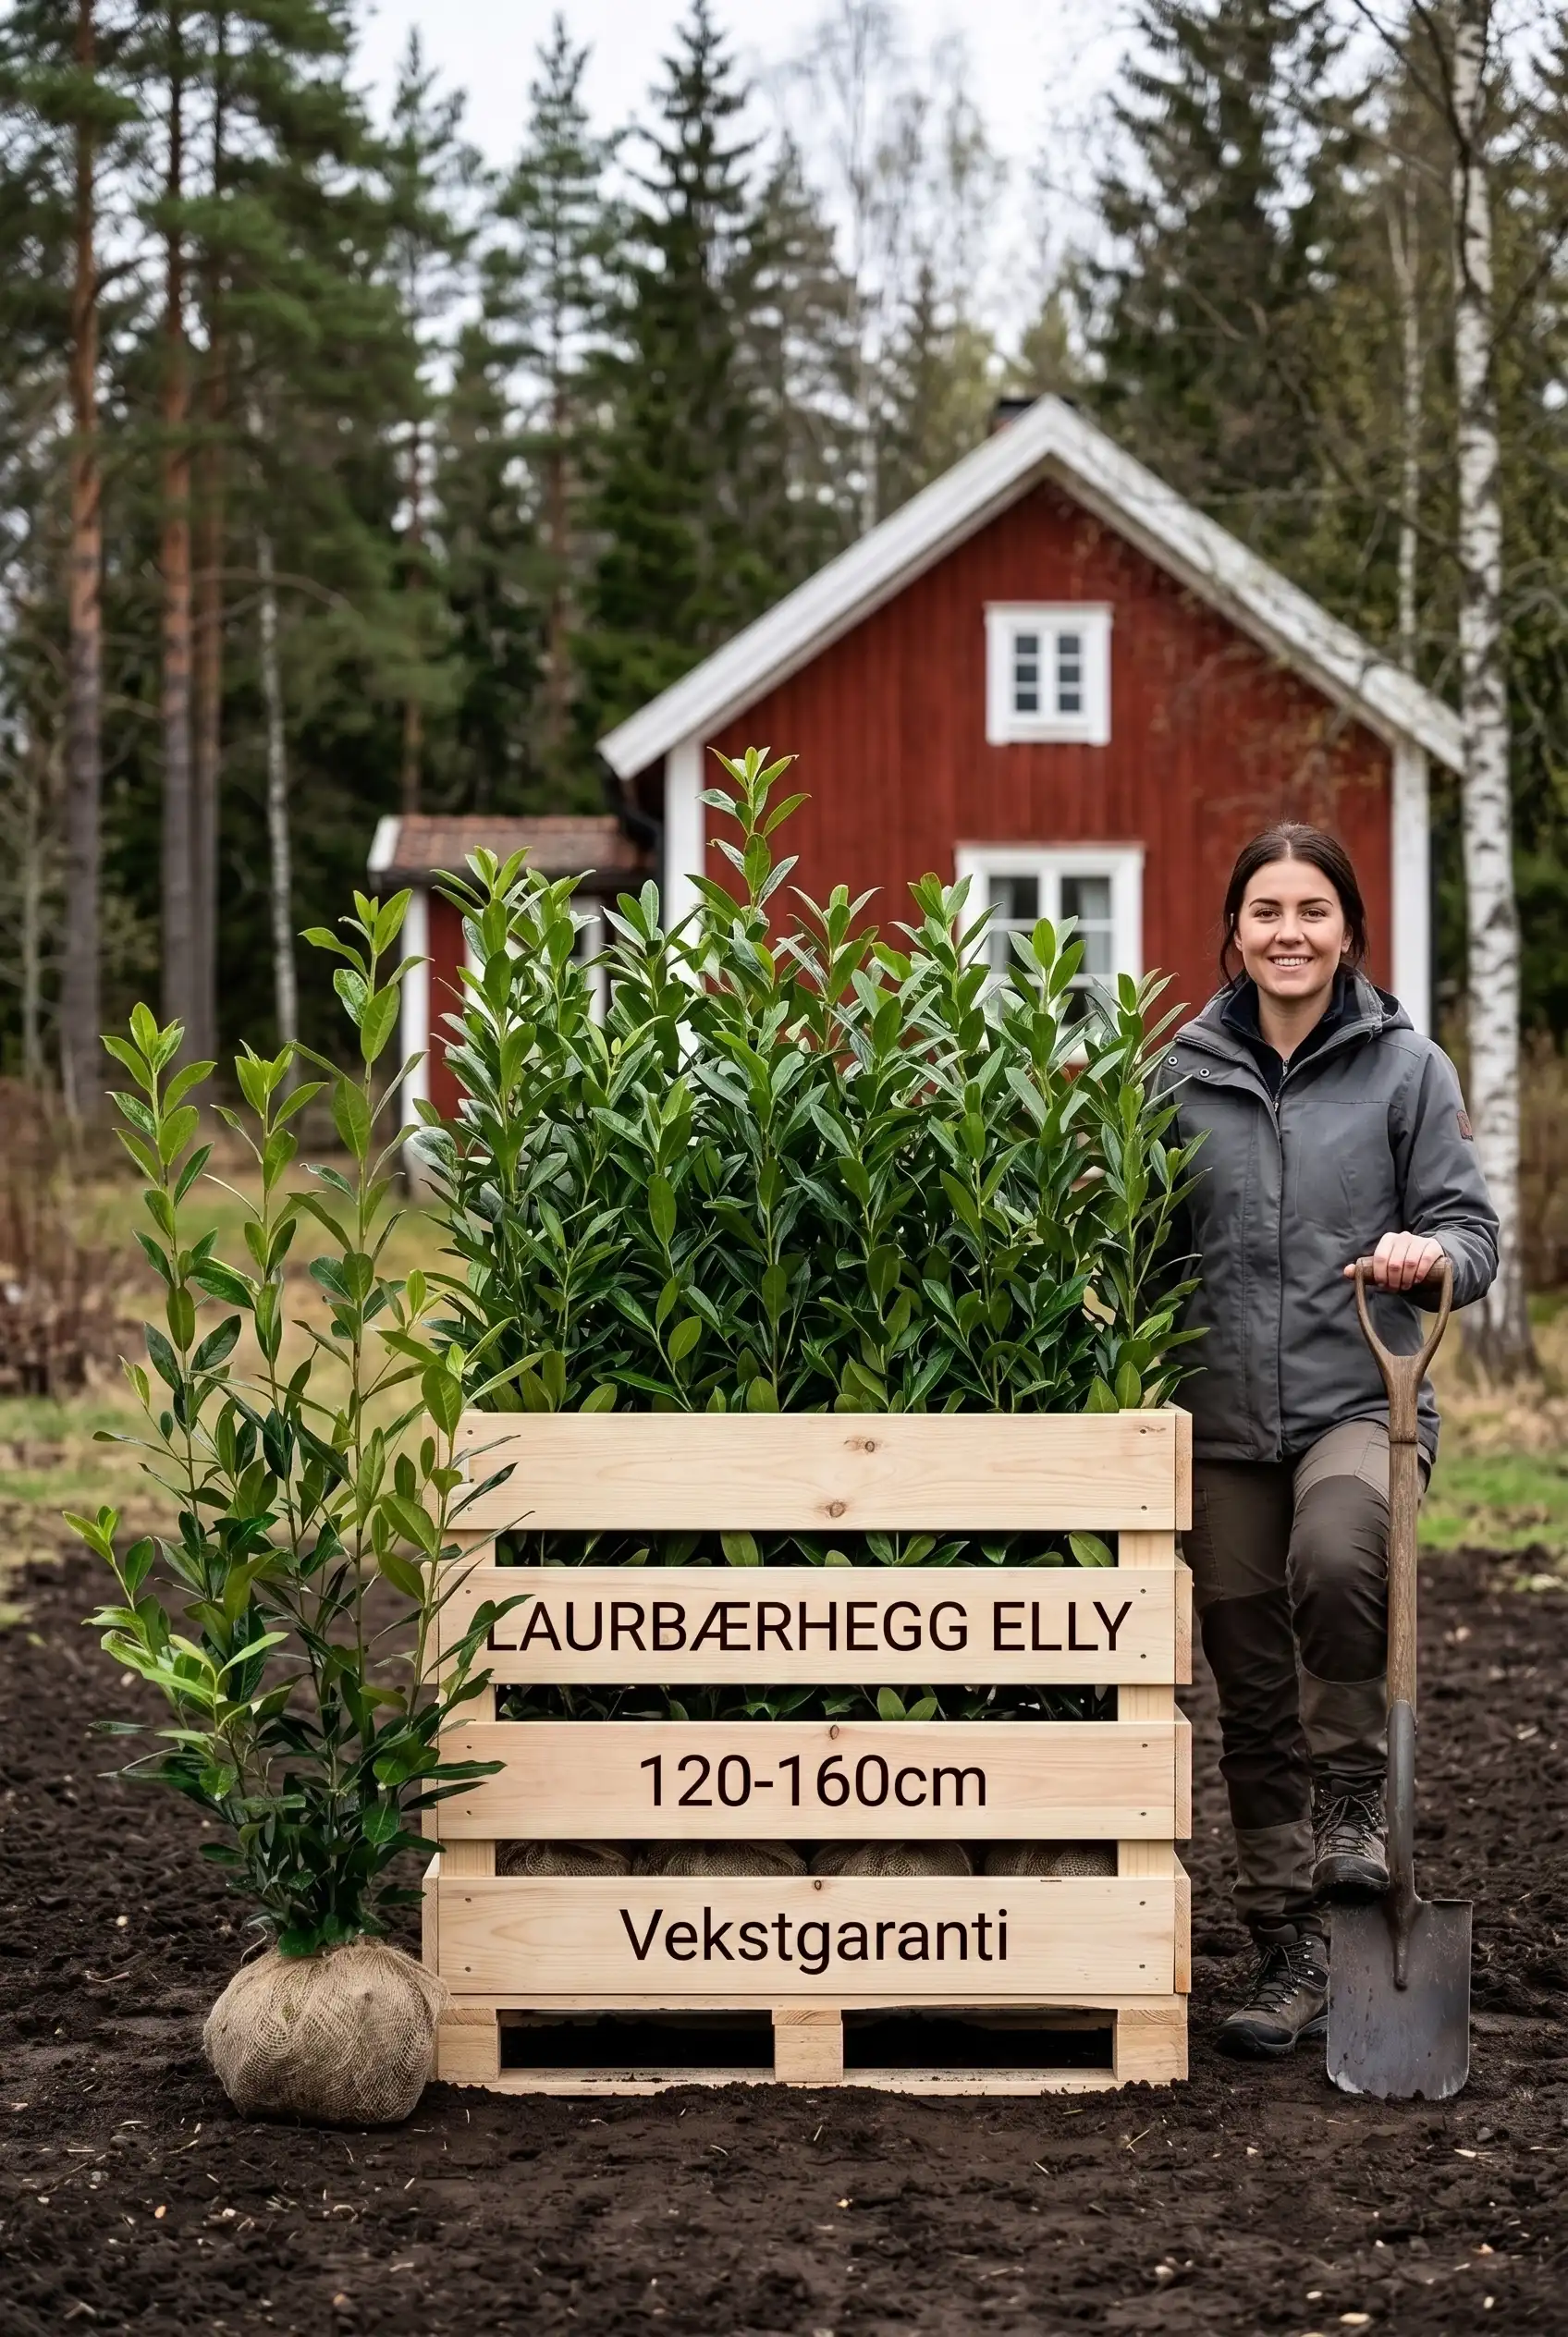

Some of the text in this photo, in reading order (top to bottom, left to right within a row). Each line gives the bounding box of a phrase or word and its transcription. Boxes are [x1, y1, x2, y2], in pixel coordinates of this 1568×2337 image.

[487, 1601, 1133, 1652] LAURBÆRHEGG ELLY
[640, 1754, 986, 1807] 120-160cm
[619, 1906, 1008, 1976] Vekstgaranti
